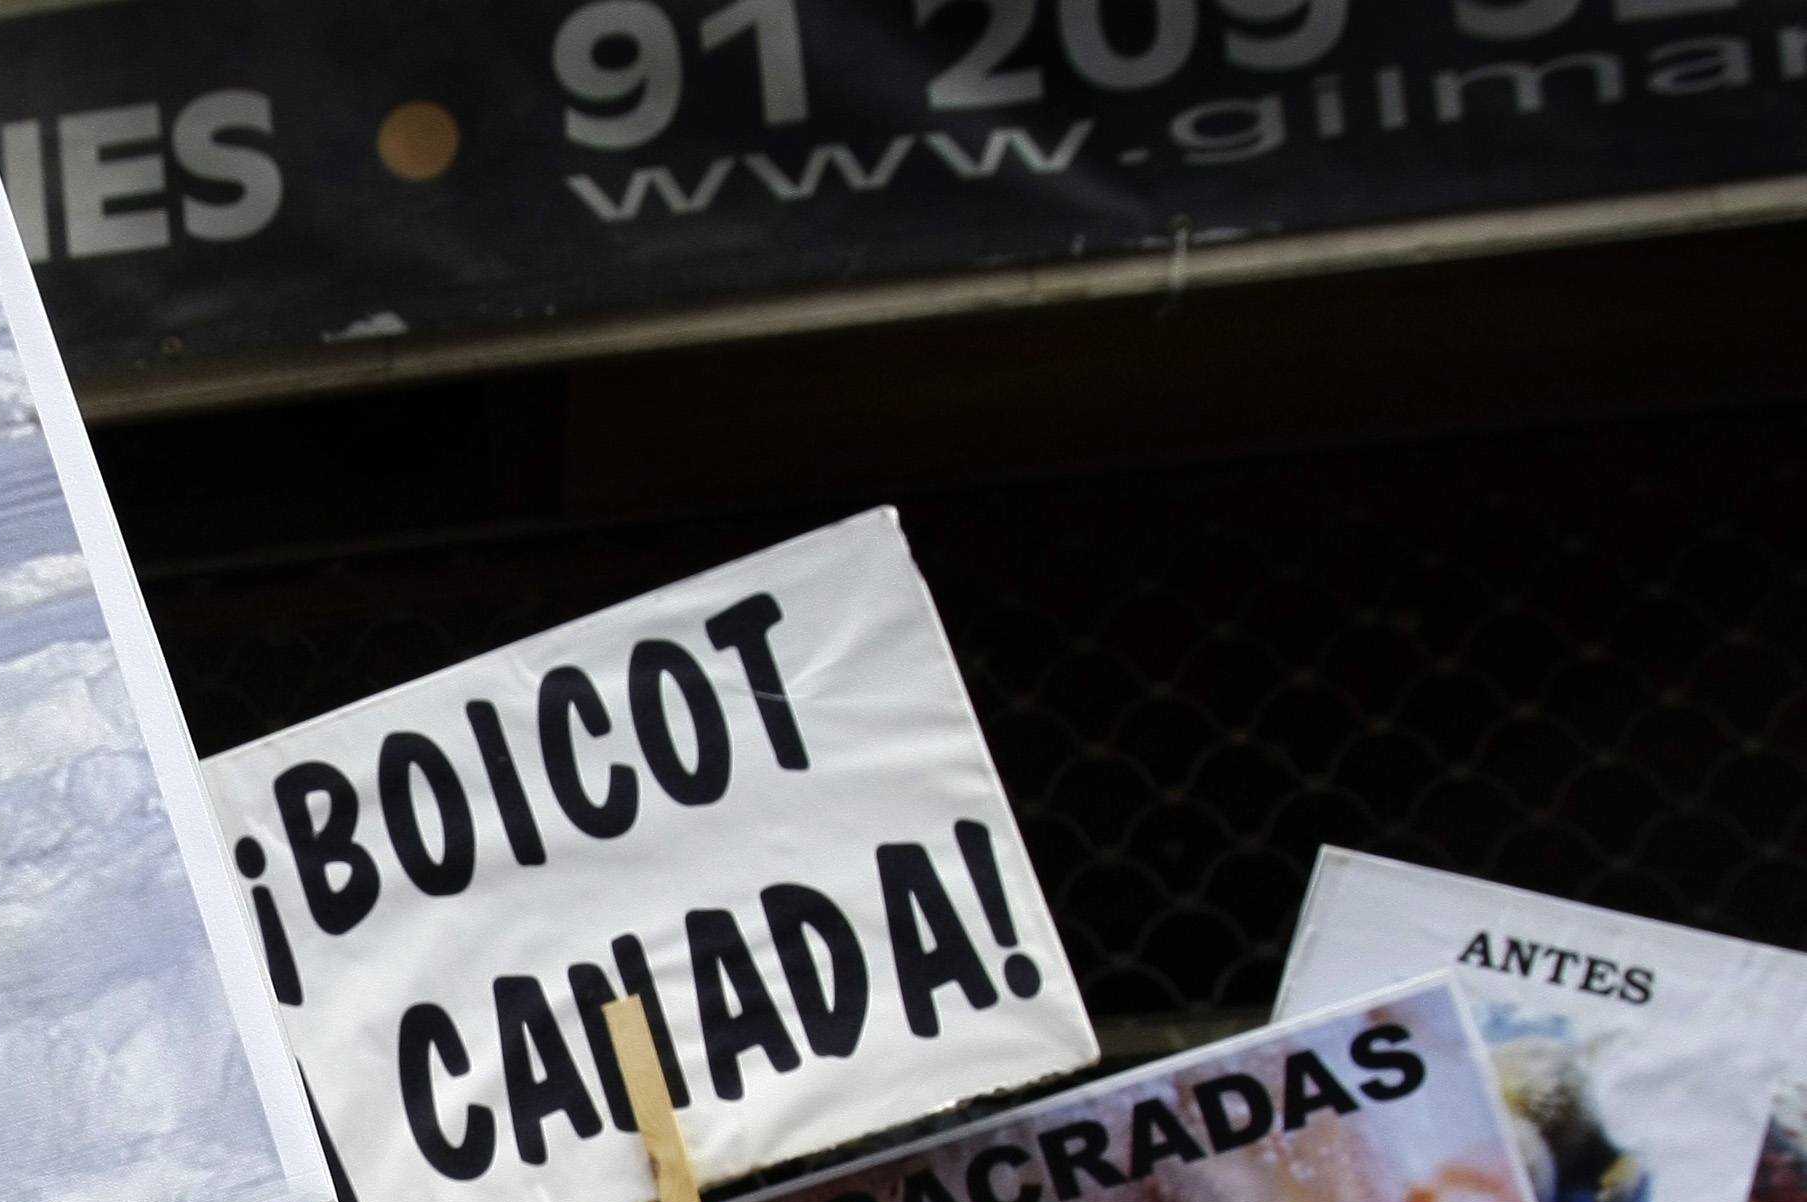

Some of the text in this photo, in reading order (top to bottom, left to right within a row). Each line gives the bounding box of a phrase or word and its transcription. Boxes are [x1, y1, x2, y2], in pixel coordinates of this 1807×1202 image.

[552, 0, 809, 149] 91
[234, 592, 810, 1006] ¡BOICOT
[398, 819, 1044, 1181] CANADA!
[1458, 930, 1655, 1006] ANTES
